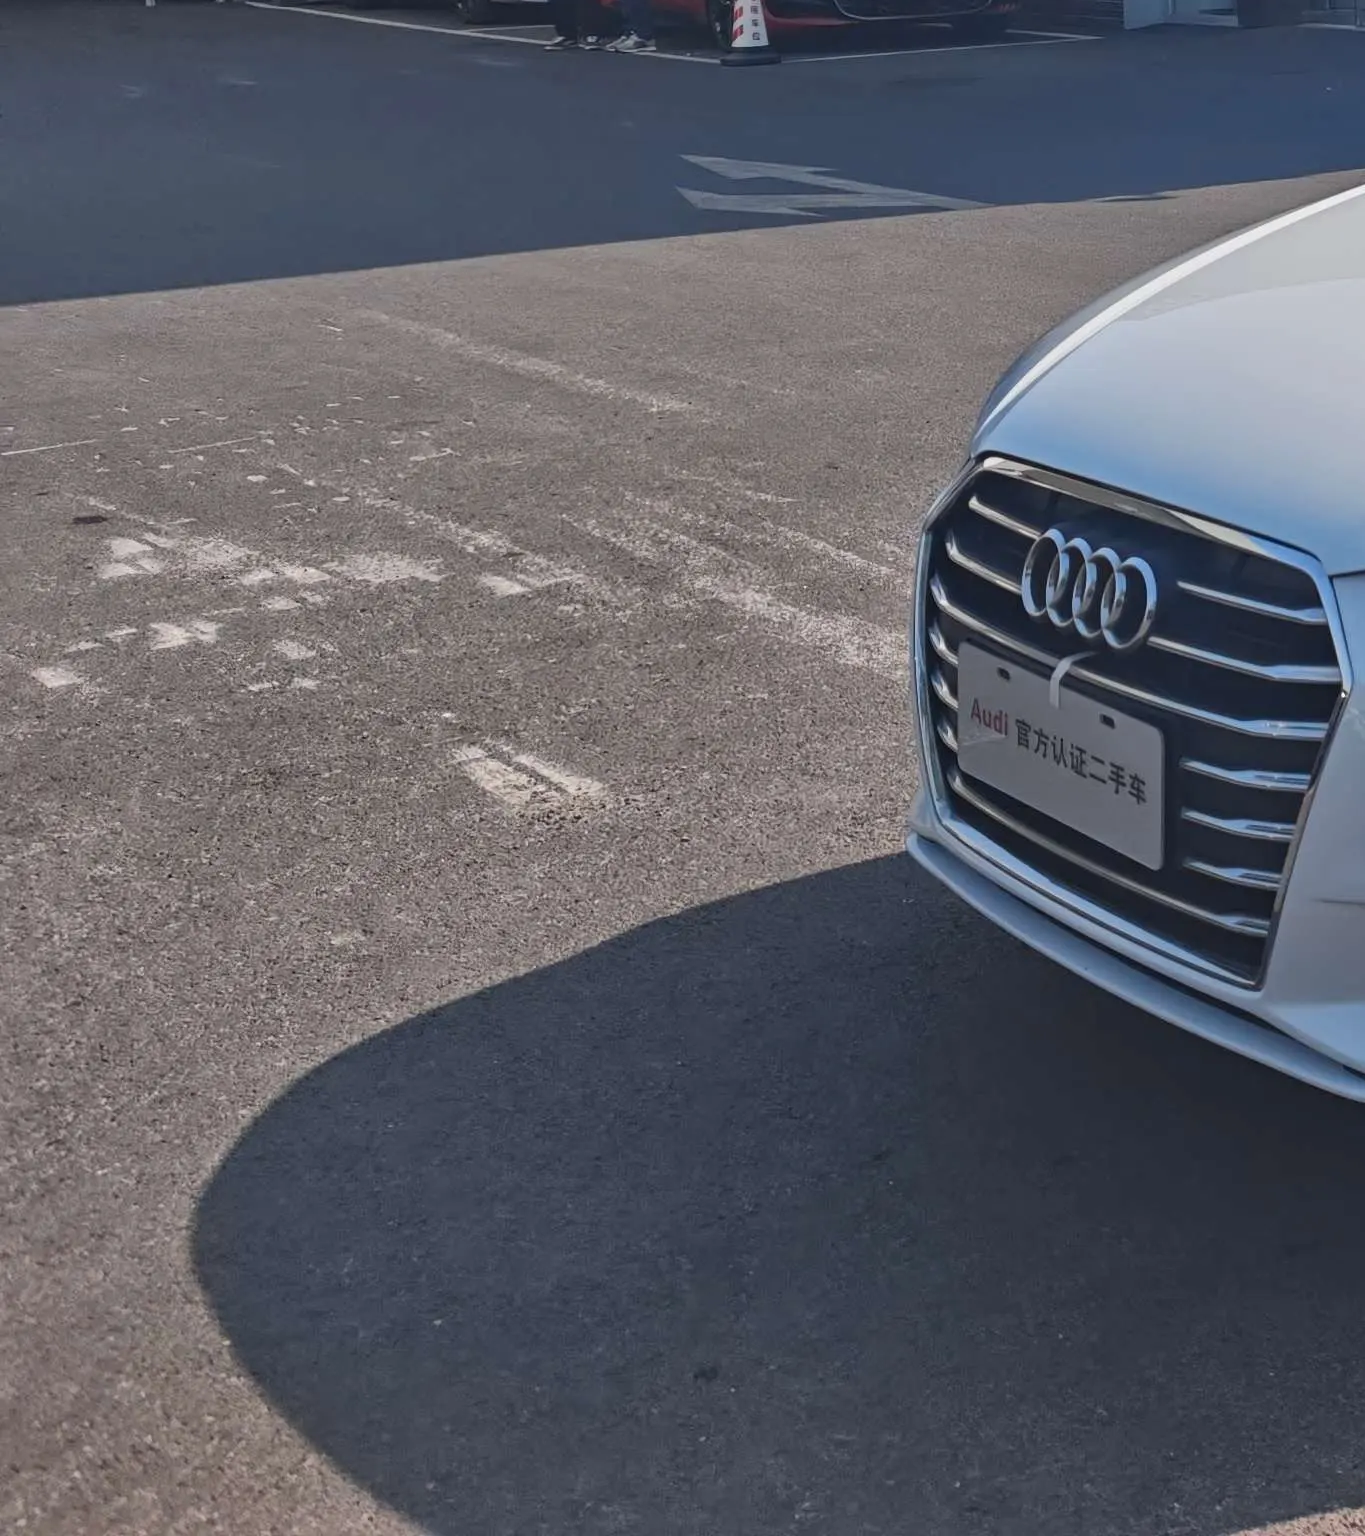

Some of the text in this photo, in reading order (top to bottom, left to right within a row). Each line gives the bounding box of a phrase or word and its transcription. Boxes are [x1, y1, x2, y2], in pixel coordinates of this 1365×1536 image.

[970, 698, 1147, 806] Audi 官方认证二手车
